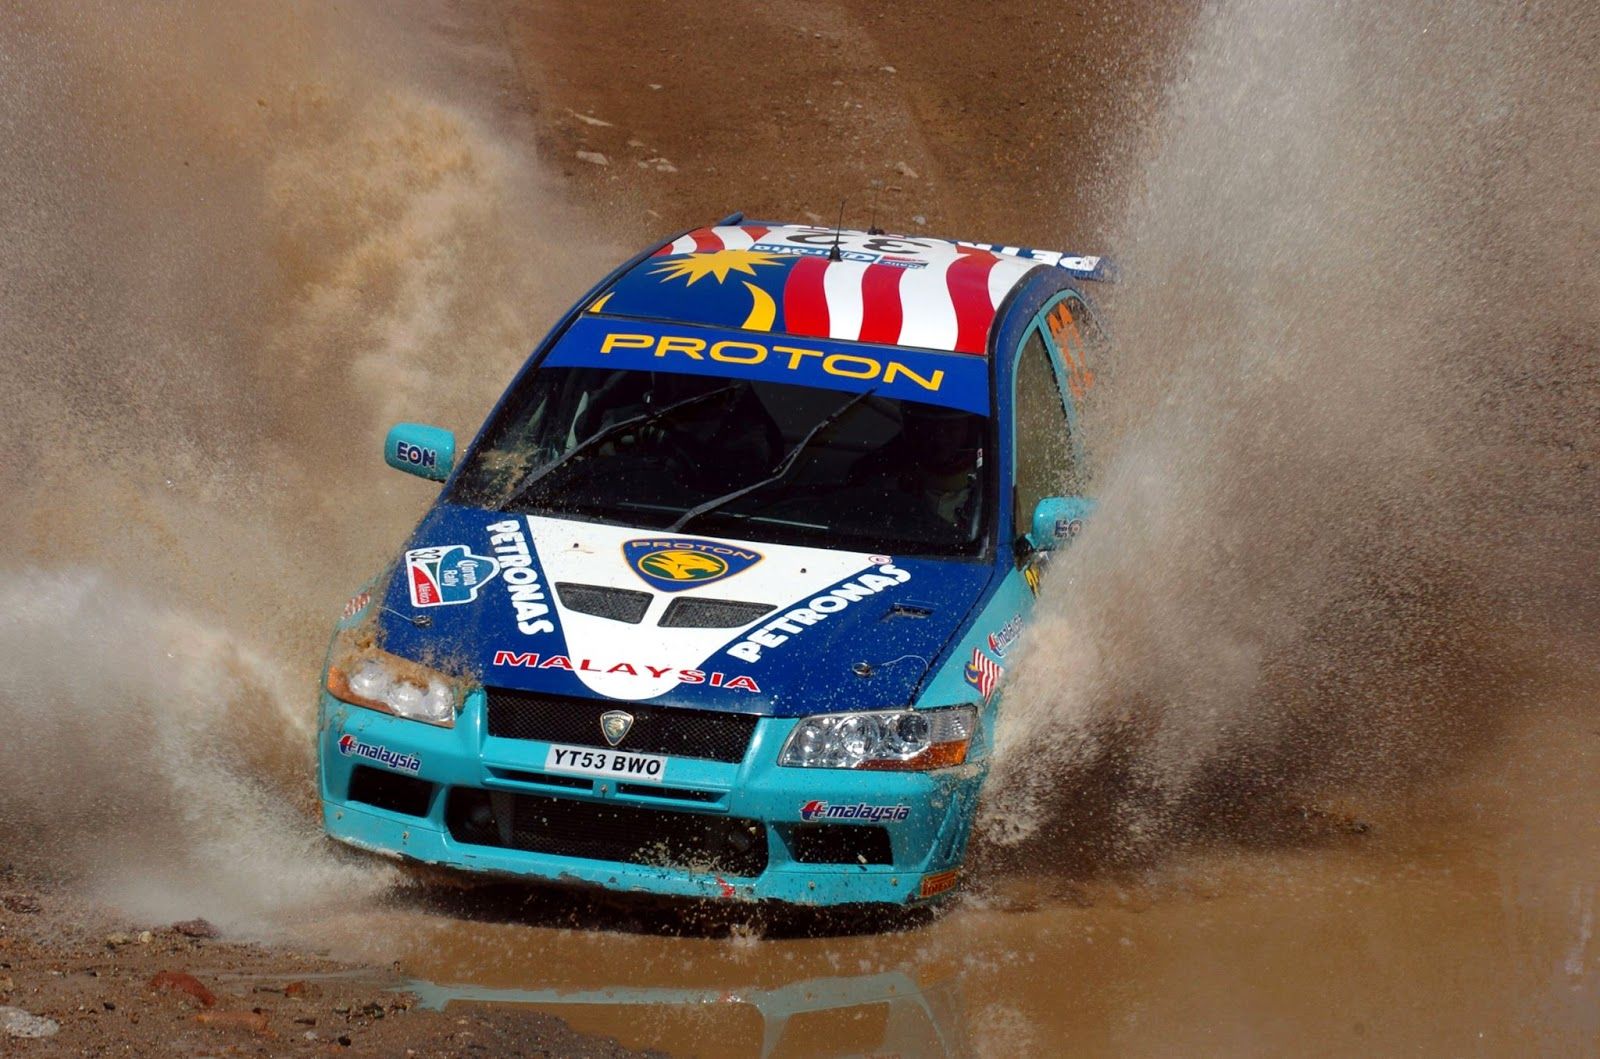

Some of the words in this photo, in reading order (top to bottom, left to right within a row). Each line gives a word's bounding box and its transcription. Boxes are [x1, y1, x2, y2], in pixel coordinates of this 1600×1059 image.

[600, 333, 945, 391] PROTON
[396, 440, 436, 469] EON
[409, 549, 442, 562] 32
[631, 541, 756, 560] PROTON
[441, 569, 460, 587] Rally
[486, 519, 555, 636] PETRONAS
[726, 563, 912, 664] PETRONAS
[493, 650, 762, 693] MALAYSIA
[356, 743, 421, 772] malaysia
[555, 748, 607, 770] YT53
[612, 755, 661, 776] BWO
[826, 803, 911, 822] malaysia
